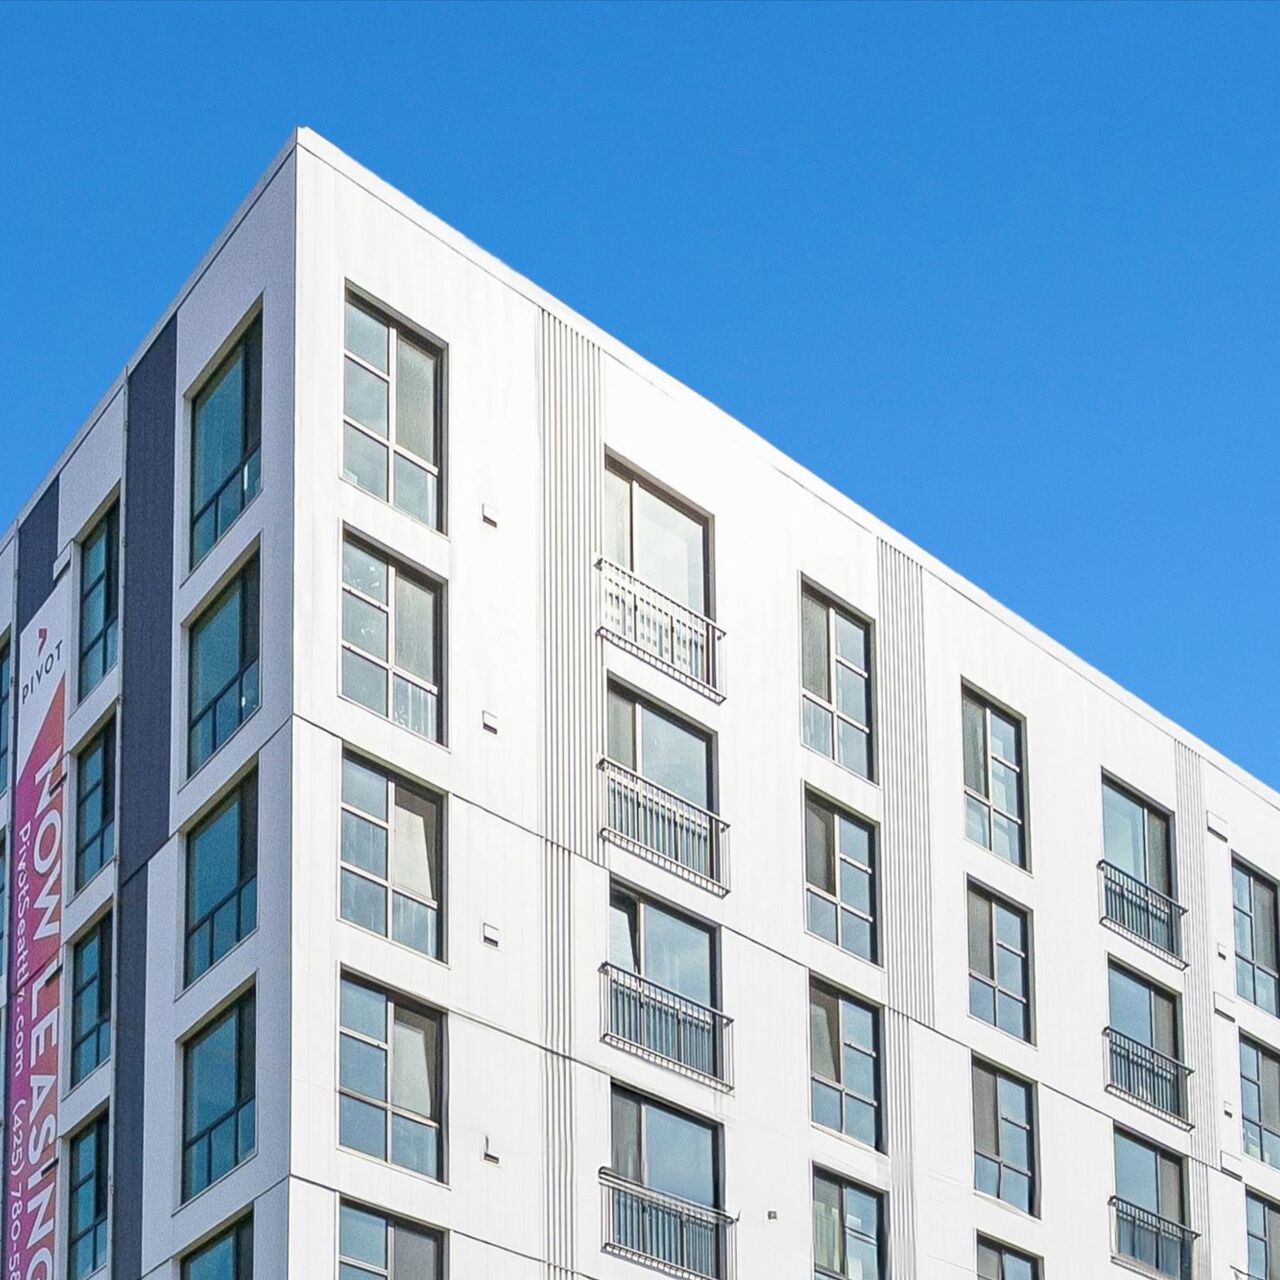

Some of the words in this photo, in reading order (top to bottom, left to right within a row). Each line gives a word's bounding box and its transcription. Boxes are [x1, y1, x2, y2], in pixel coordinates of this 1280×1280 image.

[21, 639, 63, 705] PIVOT
[33, 744, 62, 941] NOW
[11, 1099, 27, 1176] (425)
